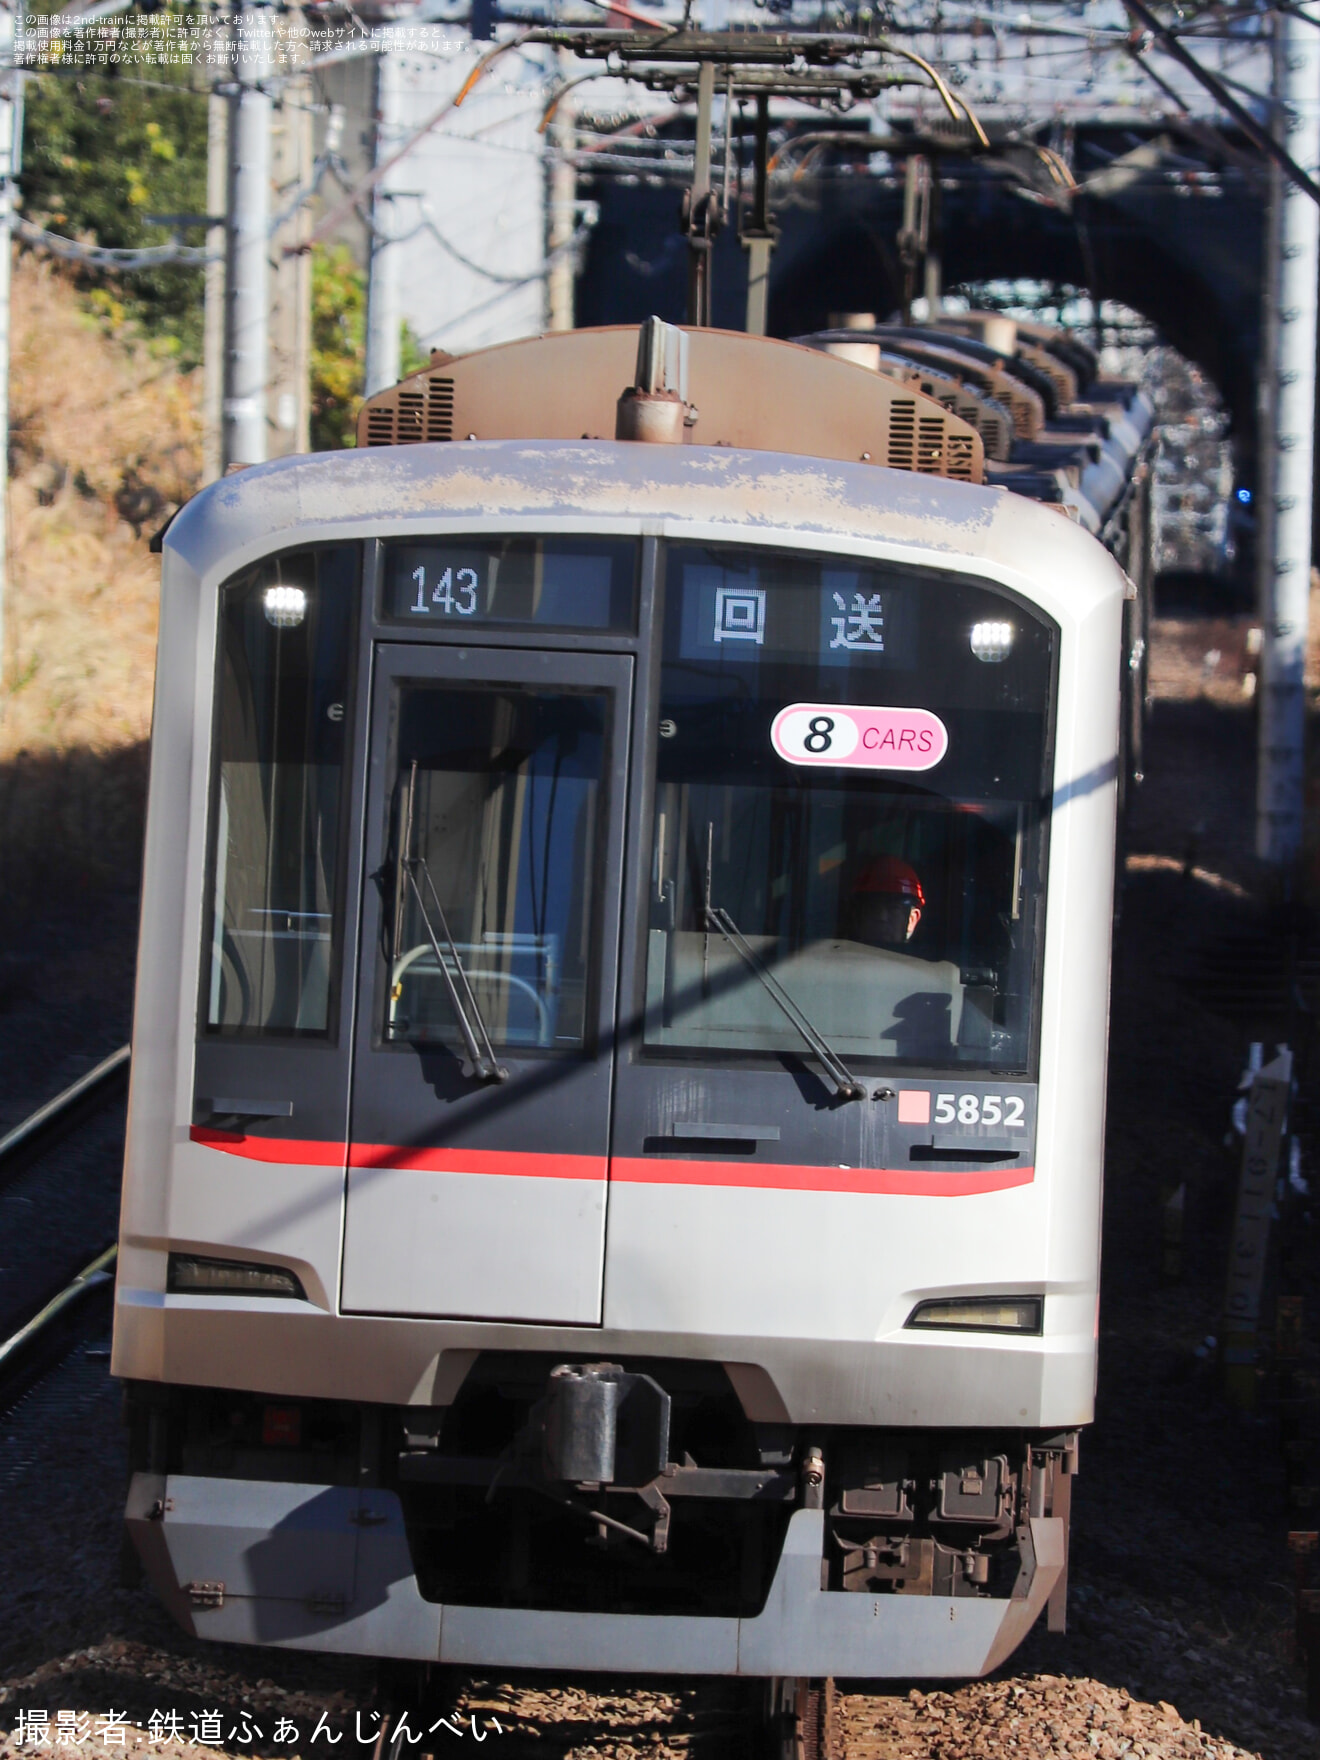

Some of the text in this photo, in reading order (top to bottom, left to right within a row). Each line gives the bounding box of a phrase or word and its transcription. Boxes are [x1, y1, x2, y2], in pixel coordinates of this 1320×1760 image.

[410, 566, 478, 615] 143
[803, 716, 934, 753] 8 CARS
[934, 1092, 1026, 1128] 5852
